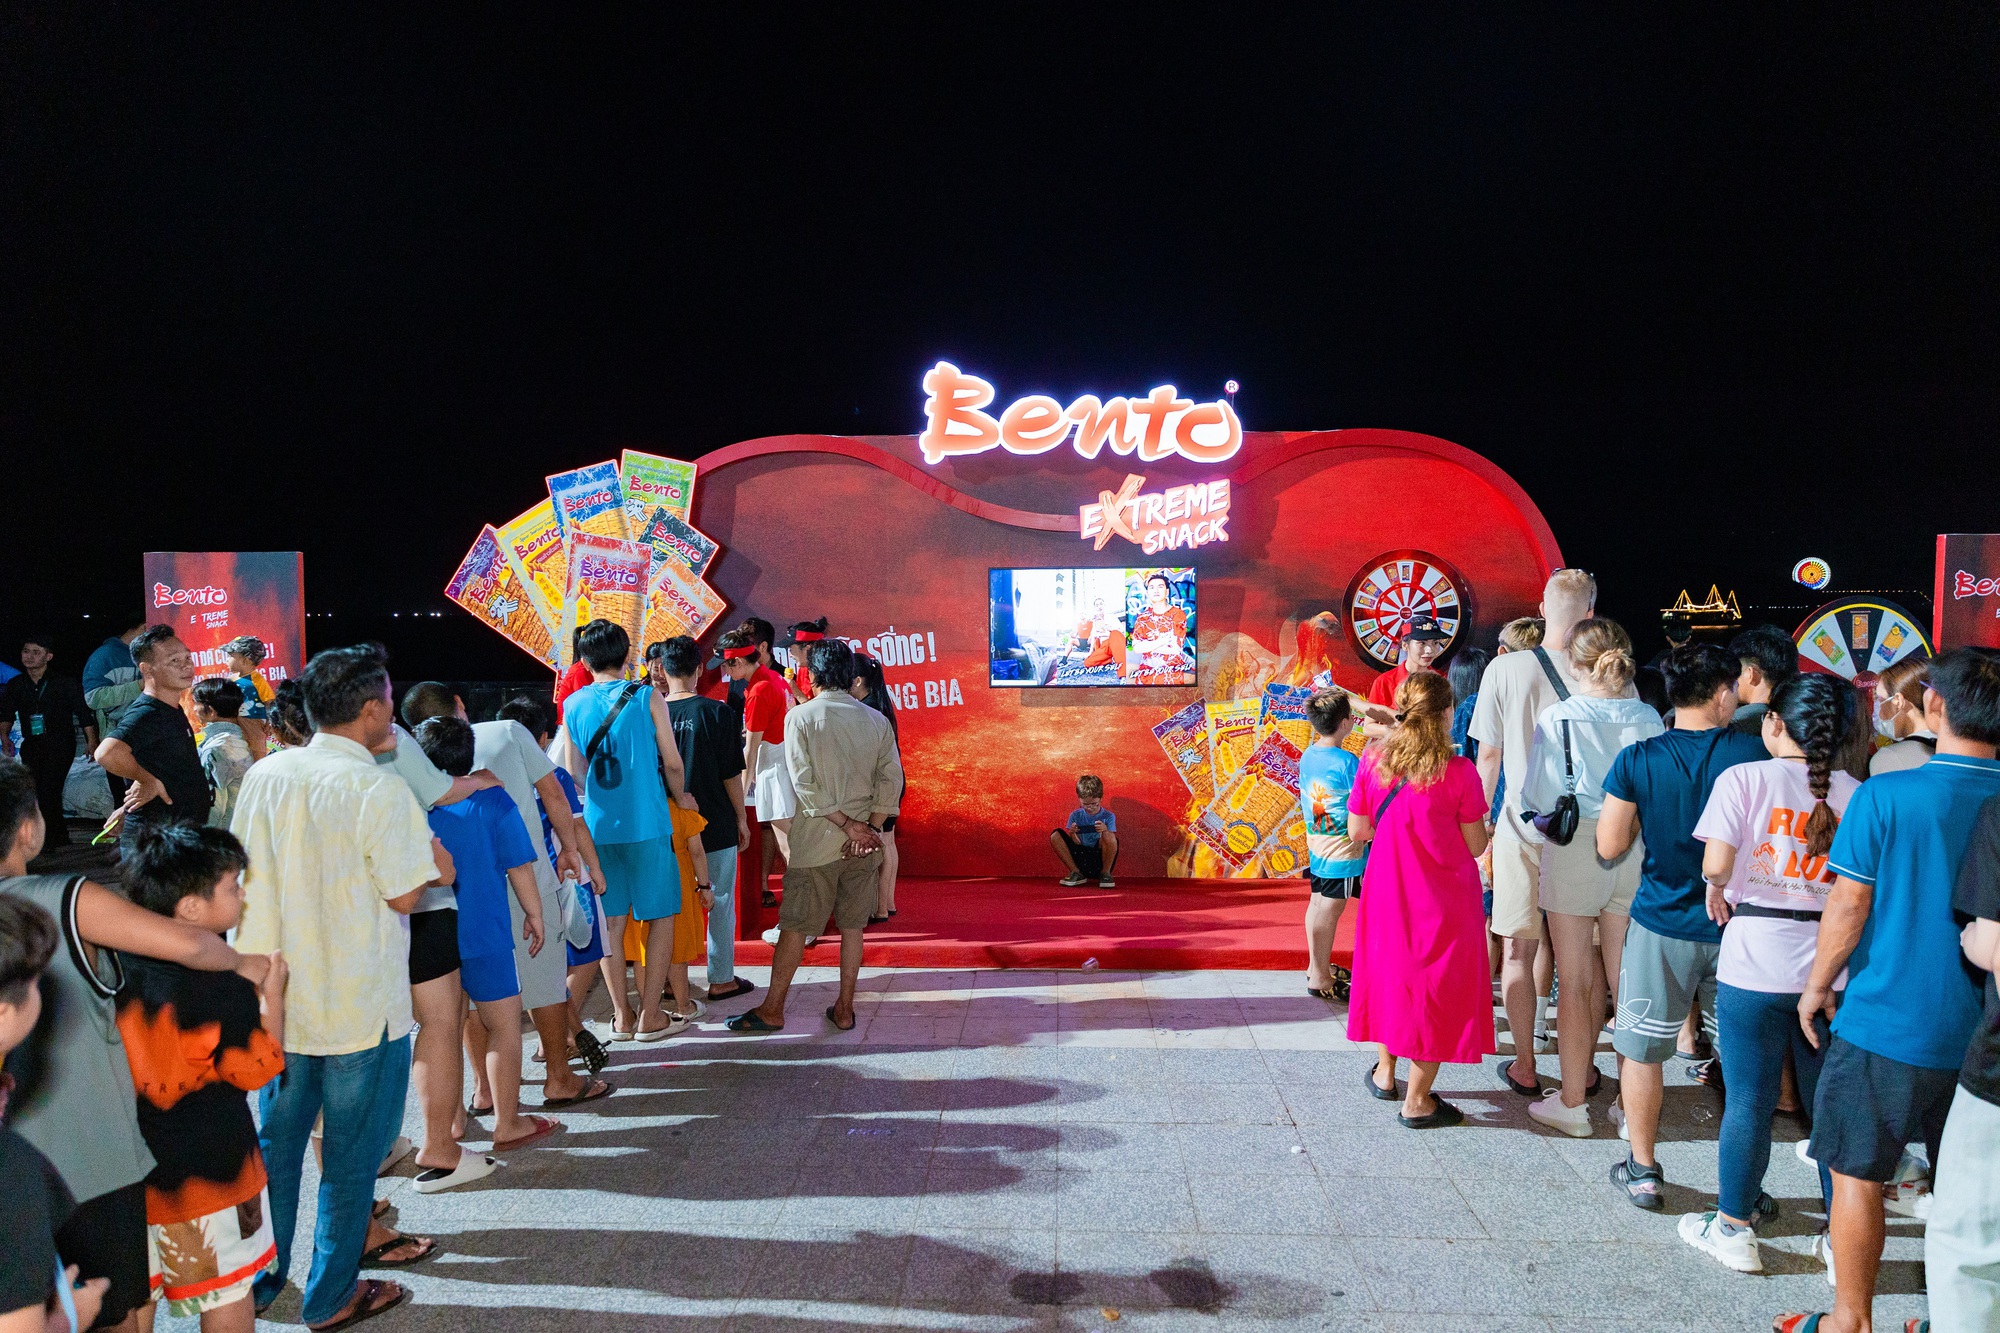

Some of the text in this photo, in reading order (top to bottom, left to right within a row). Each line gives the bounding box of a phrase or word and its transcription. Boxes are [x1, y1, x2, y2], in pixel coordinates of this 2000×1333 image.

[920, 361, 1242, 464] Bento
[629, 474, 681, 499] Bento
[564, 491, 613, 513] Bento
[1082, 474, 1230, 550] EXTREME
[652, 521, 702, 562] Bento
[1143, 516, 1230, 554] SNACK
[580, 557, 638, 585] Bento
[1954, 570, 2000, 600] Be
[154, 583, 227, 608] Bento
[206, 619, 228, 629] SNACK
[269, 666, 288, 681] BIA
[925, 678, 964, 708] BIA
[1215, 717, 1256, 730] Bento
